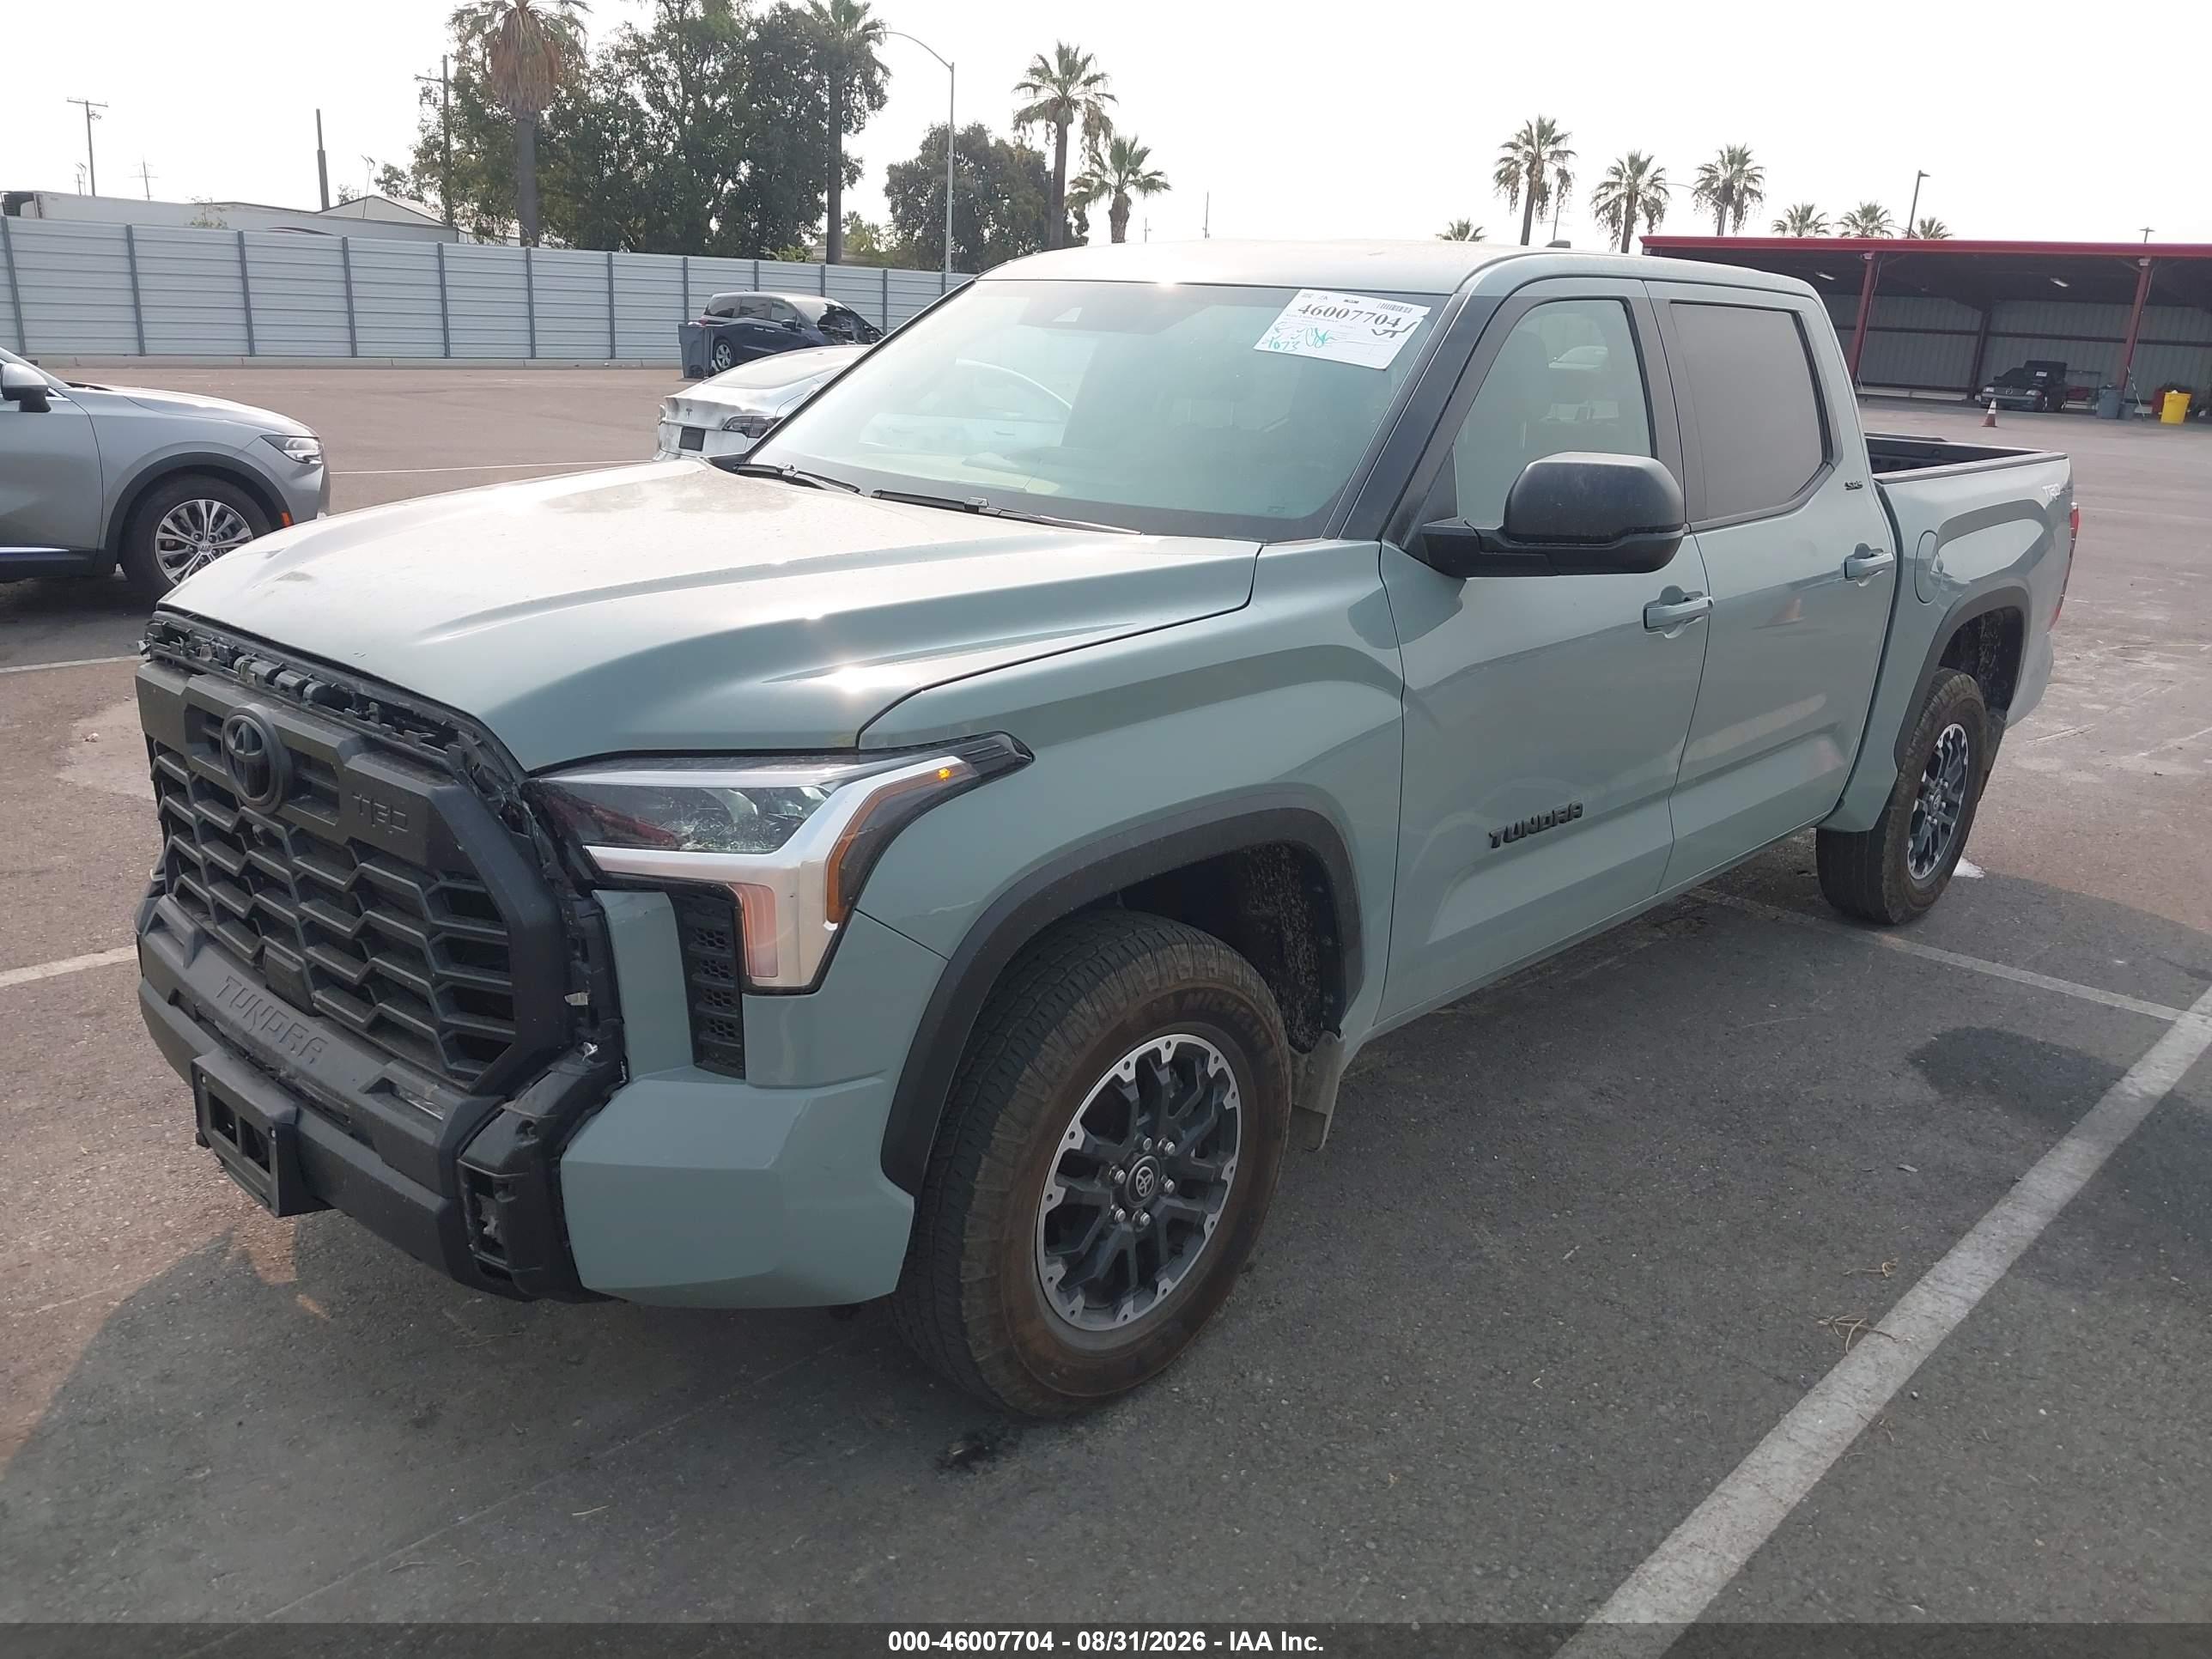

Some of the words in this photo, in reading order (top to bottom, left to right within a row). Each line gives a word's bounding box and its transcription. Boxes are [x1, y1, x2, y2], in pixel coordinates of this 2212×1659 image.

[1297, 303, 1402, 328] 46007704
[351, 792, 409, 834] TRD
[1488, 801, 1583, 848] TUNDRA
[216, 975, 329, 1065] TUNDRA
